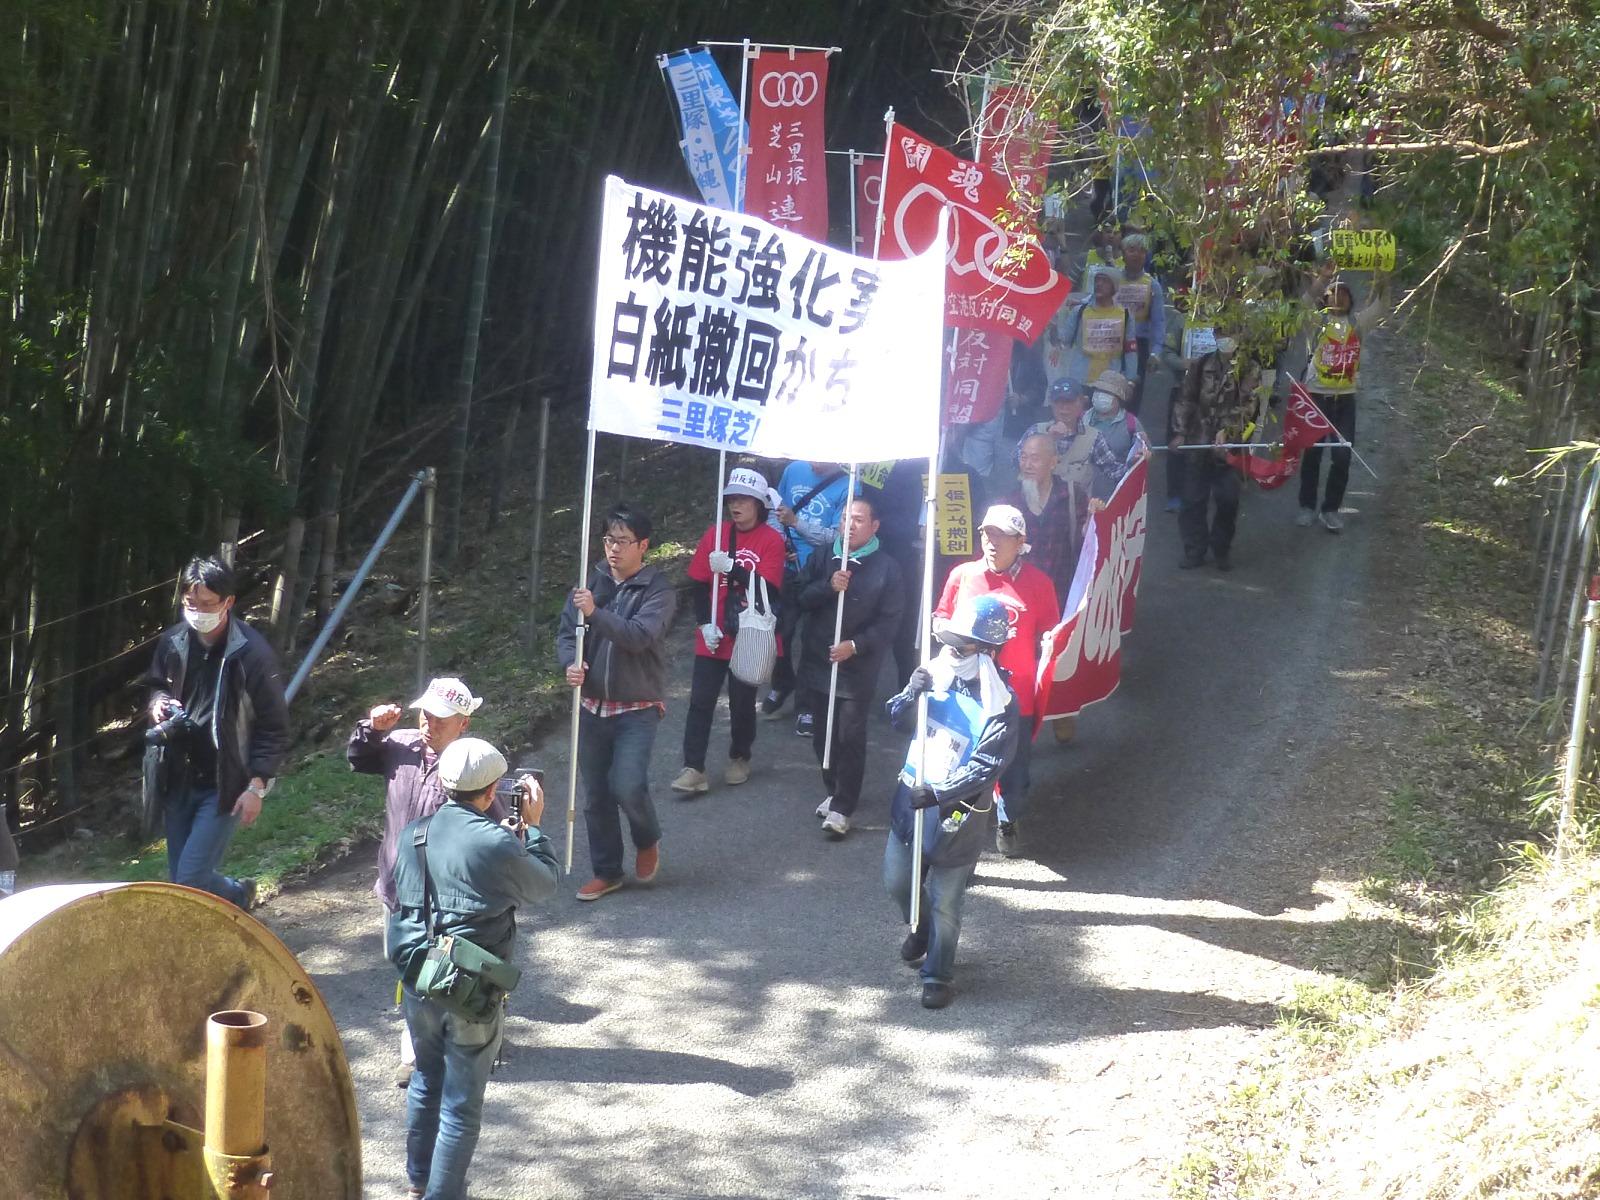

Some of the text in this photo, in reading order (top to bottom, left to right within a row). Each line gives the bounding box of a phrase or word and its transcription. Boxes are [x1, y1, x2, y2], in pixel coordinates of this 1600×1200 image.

[765, 122, 783, 185] 芝山
[786, 121, 807, 185] 三里塚
[656, 398, 762, 447] 三里塚芝
